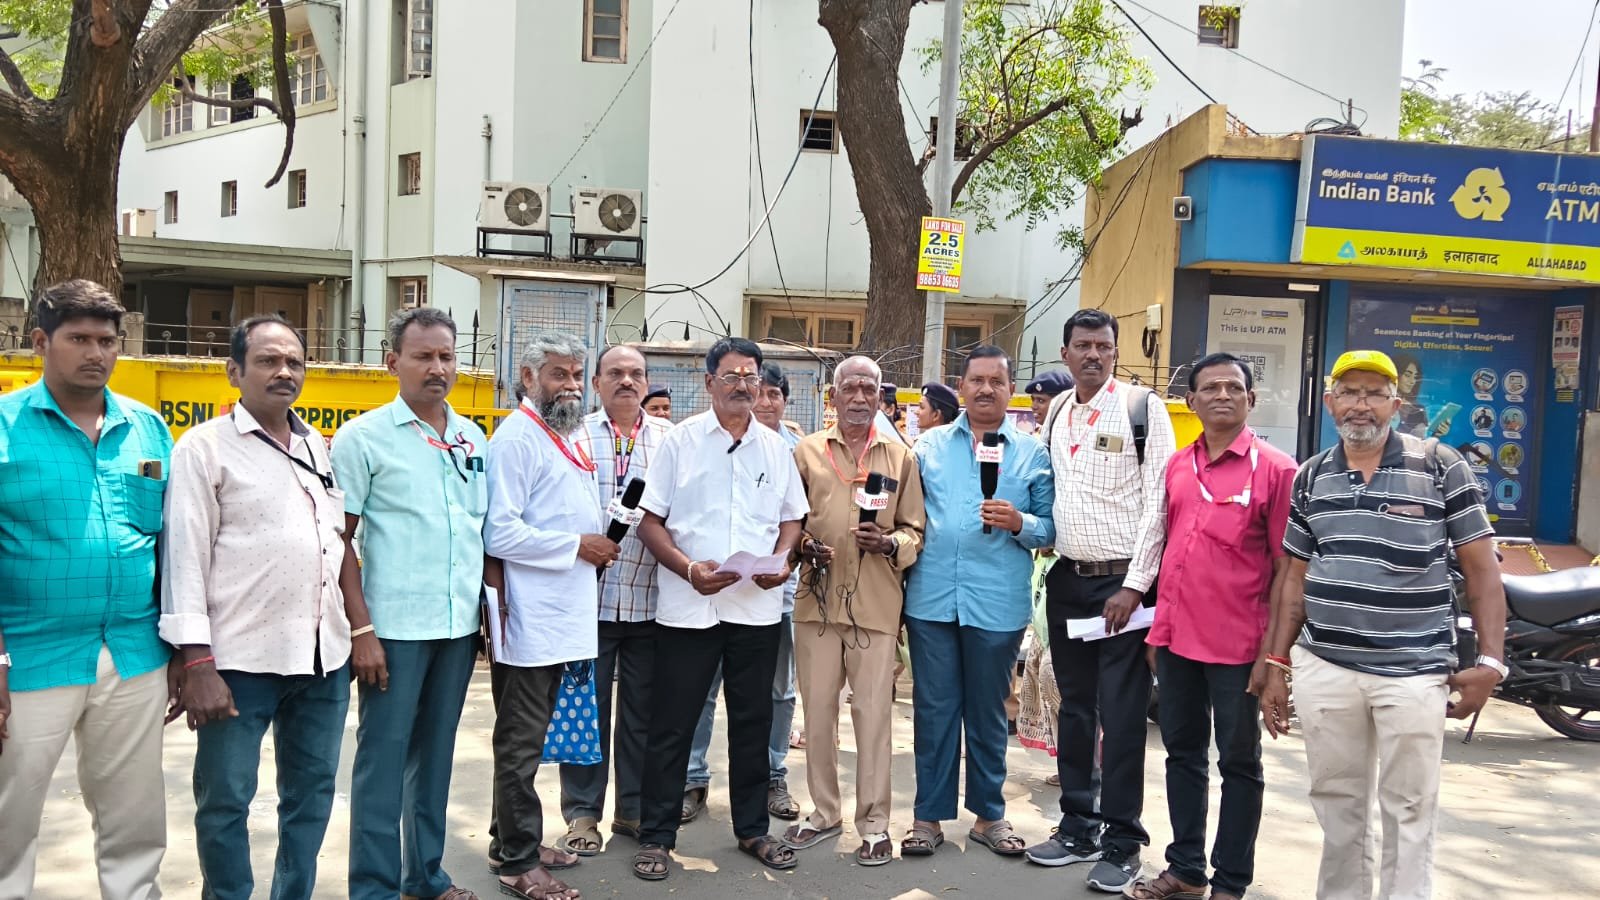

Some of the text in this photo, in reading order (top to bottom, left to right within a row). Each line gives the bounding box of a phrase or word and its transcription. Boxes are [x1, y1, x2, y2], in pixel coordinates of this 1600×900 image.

[1322, 168, 1363, 179] இந்தியன்
[1319, 180, 1436, 205] Indian Bank
[1545, 198, 1600, 223] ATM
[925, 219, 940, 231] LAND
[941, 221, 951, 232] FOR
[928, 232, 959, 248] 2.5
[924, 247, 960, 257] ACRES
[1360, 246, 1428, 260] அலகாபாத்
[1443, 250, 1500, 265] इलाहाबाद
[1527, 257, 1587, 271] ALLAHABAD
[1221, 324, 1238, 332] This
[1250, 325, 1265, 334] UPI
[1267, 327, 1286, 335] ATM
[1374, 328, 1411, 336] Seamless
[1412, 329, 1444, 338] Banking
[1473, 332, 1514, 341] Fingertips!
